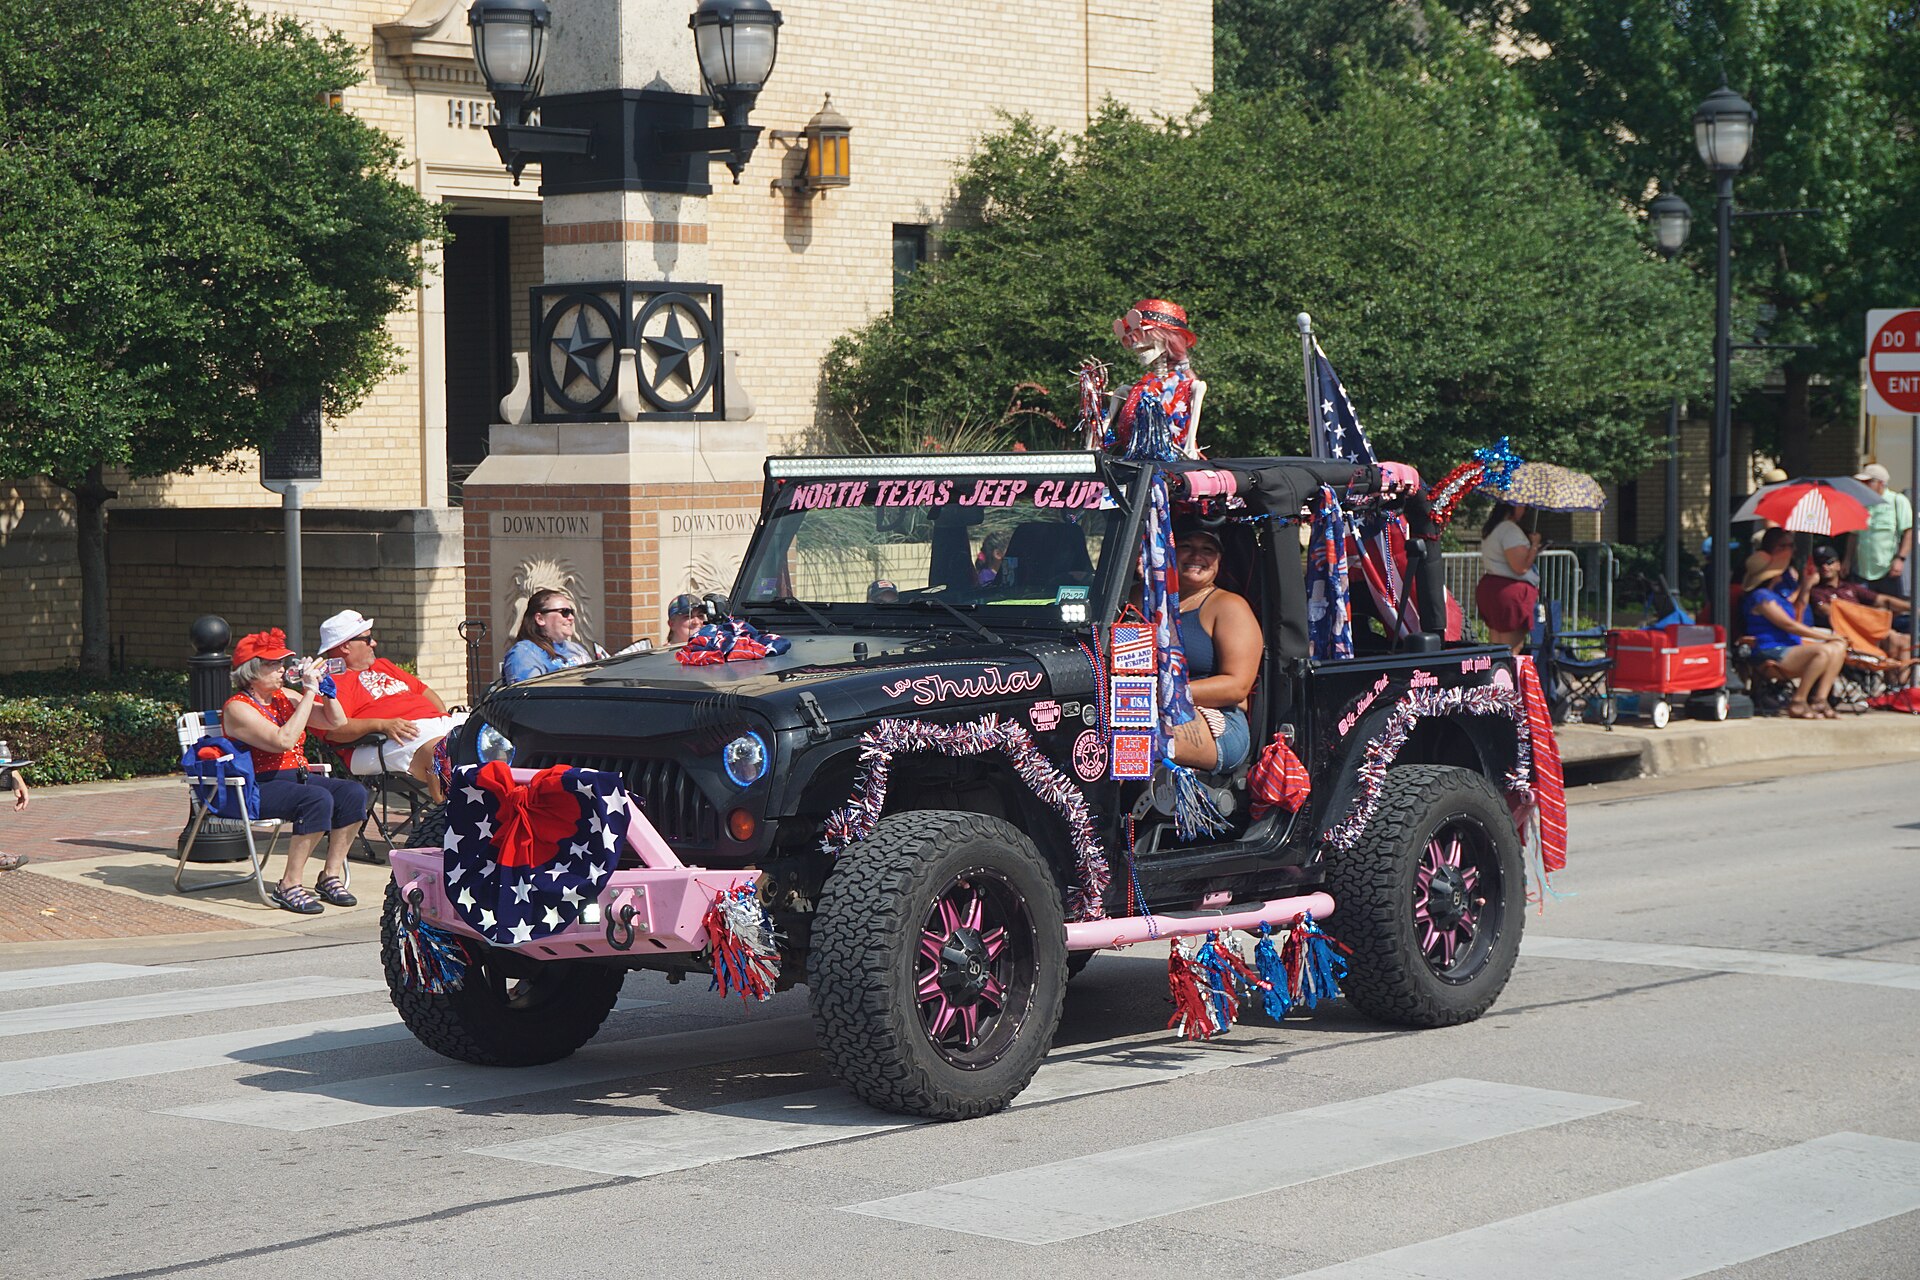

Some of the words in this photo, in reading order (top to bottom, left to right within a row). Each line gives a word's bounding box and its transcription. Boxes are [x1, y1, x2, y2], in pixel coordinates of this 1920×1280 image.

[1882, 330, 1905, 348] DO
[789, 481, 869, 511] NORTH
[874, 479, 954, 507] TEXAS
[958, 479, 1028, 508] JEEP
[1034, 480, 1106, 509] CLUB
[503, 515, 590, 534] DOWNTOWN
[672, 513, 757, 533] DOWNTOWN
[1138, 649, 1152, 658] AND
[1125, 657, 1150, 668] STRIPES
[1034, 700, 1056, 711] BREW
[1116, 696, 1122, 708] I
[1130, 696, 1150, 708] USA
[1035, 721, 1057, 732] CREW
[1076, 734, 1091, 757] NORTH
[1122, 739, 1142, 749] LET
[1115, 750, 1149, 760] FREEDOM
[1078, 764, 1090, 777] JEEP
[1090, 761, 1104, 777] CLUB
[1119, 762, 1145, 771] RING
